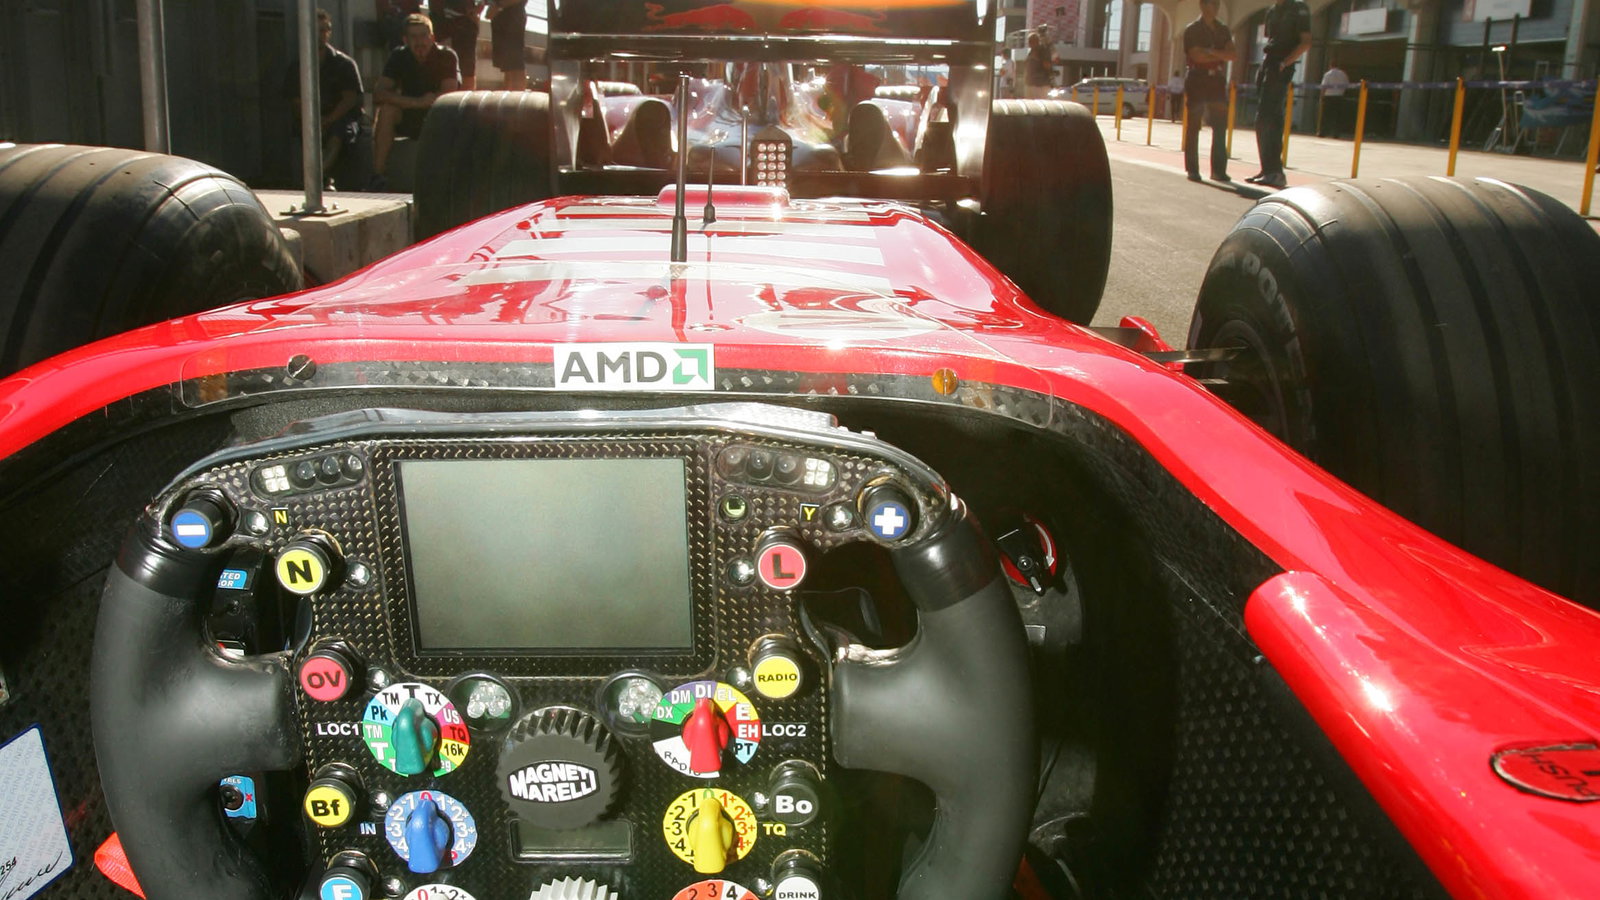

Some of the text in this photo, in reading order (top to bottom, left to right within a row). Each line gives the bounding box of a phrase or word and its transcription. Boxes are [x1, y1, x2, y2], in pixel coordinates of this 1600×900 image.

[560, 351, 667, 383] AMD
[274, 510, 288, 524] N
[803, 507, 816, 520] Y
[286, 559, 314, 584] N
[772, 553, 796, 579] L
[307, 670, 341, 689] OV
[758, 673, 797, 682] RADIO
[671, 690, 691, 704] DM
[695, 684, 712, 698] DI
[717, 689, 736, 701] EL
[382, 692, 400, 705] TM
[425, 692, 441, 705] TX
[370, 706, 388, 721] Pk
[442, 707, 460, 724] US
[657, 706, 674, 719] DX
[736, 703, 750, 720] E
[317, 723, 359, 736] LOC1
[364, 724, 383, 738] TM
[449, 726, 466, 741] TQ
[738, 724, 759, 738] EH
[762, 724, 807, 737] LOC2
[370, 742, 389, 760] T
[444, 743, 464, 756] 16k
[735, 743, 753, 755] PT
[311, 799, 340, 817] Bf
[775, 795, 813, 814] Bo
[360, 823, 377, 835] IN
[763, 823, 787, 836] TQ
[707, 883, 718, 897] 3
[726, 885, 738, 900] 4
[778, 891, 817, 899] DRINK
